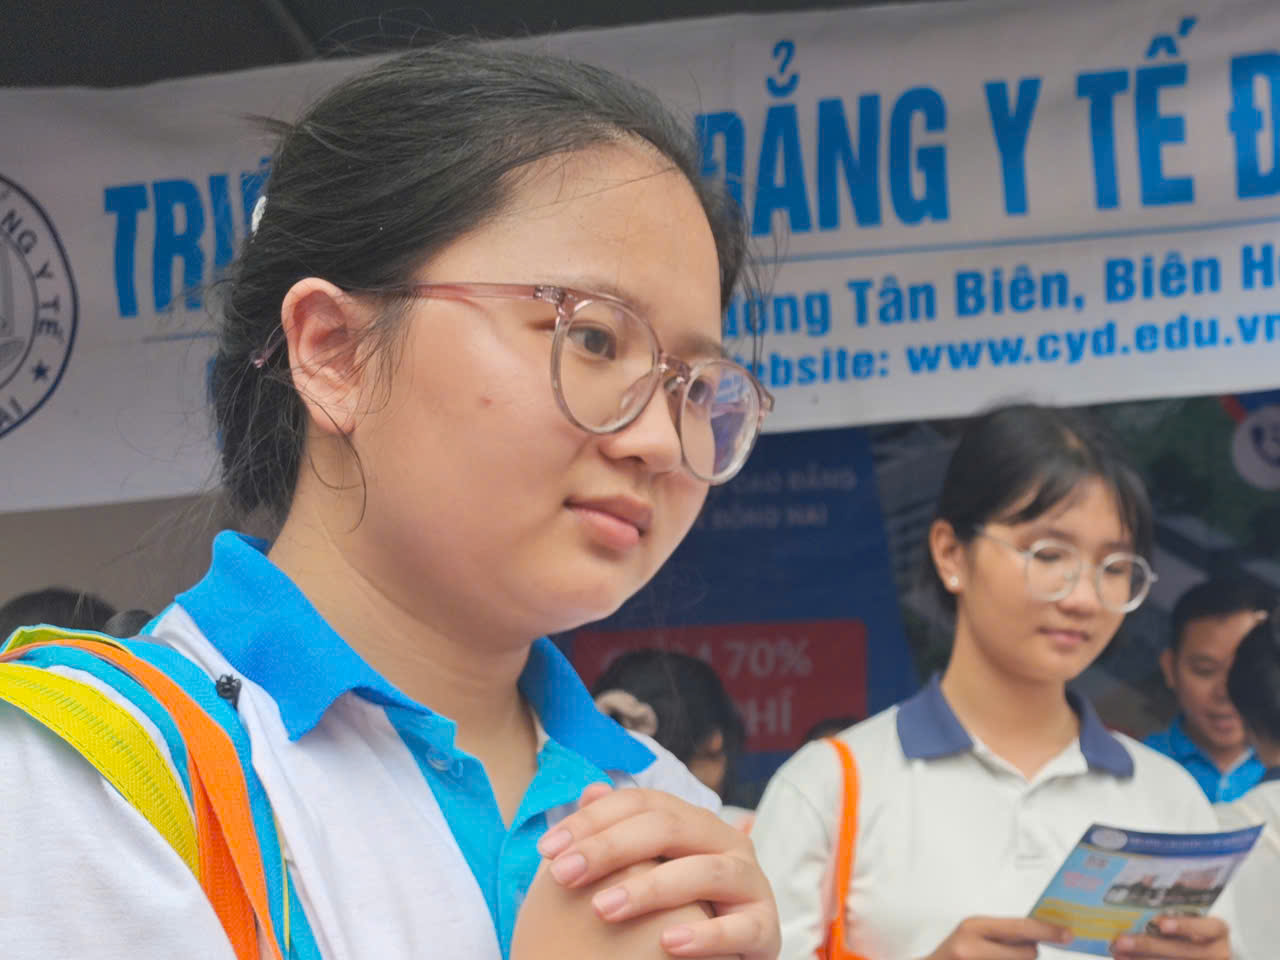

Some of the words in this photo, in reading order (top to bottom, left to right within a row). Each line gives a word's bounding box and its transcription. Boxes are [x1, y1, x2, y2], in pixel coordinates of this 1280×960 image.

[104, 157, 270, 318] TRƯ
[695, 39, 950, 237] ĐẲNG
[985, 77, 1042, 216] Y
[1076, 18, 1197, 210] TẾ
[845, 275, 937, 327] Tân
[954, 264, 1086, 317] Biên,
[1104, 251, 1221, 303] Biên
[733, 347, 890, 389] ebsite:
[726, 639, 812, 677] 70%
[745, 688, 794, 736] HÍ
